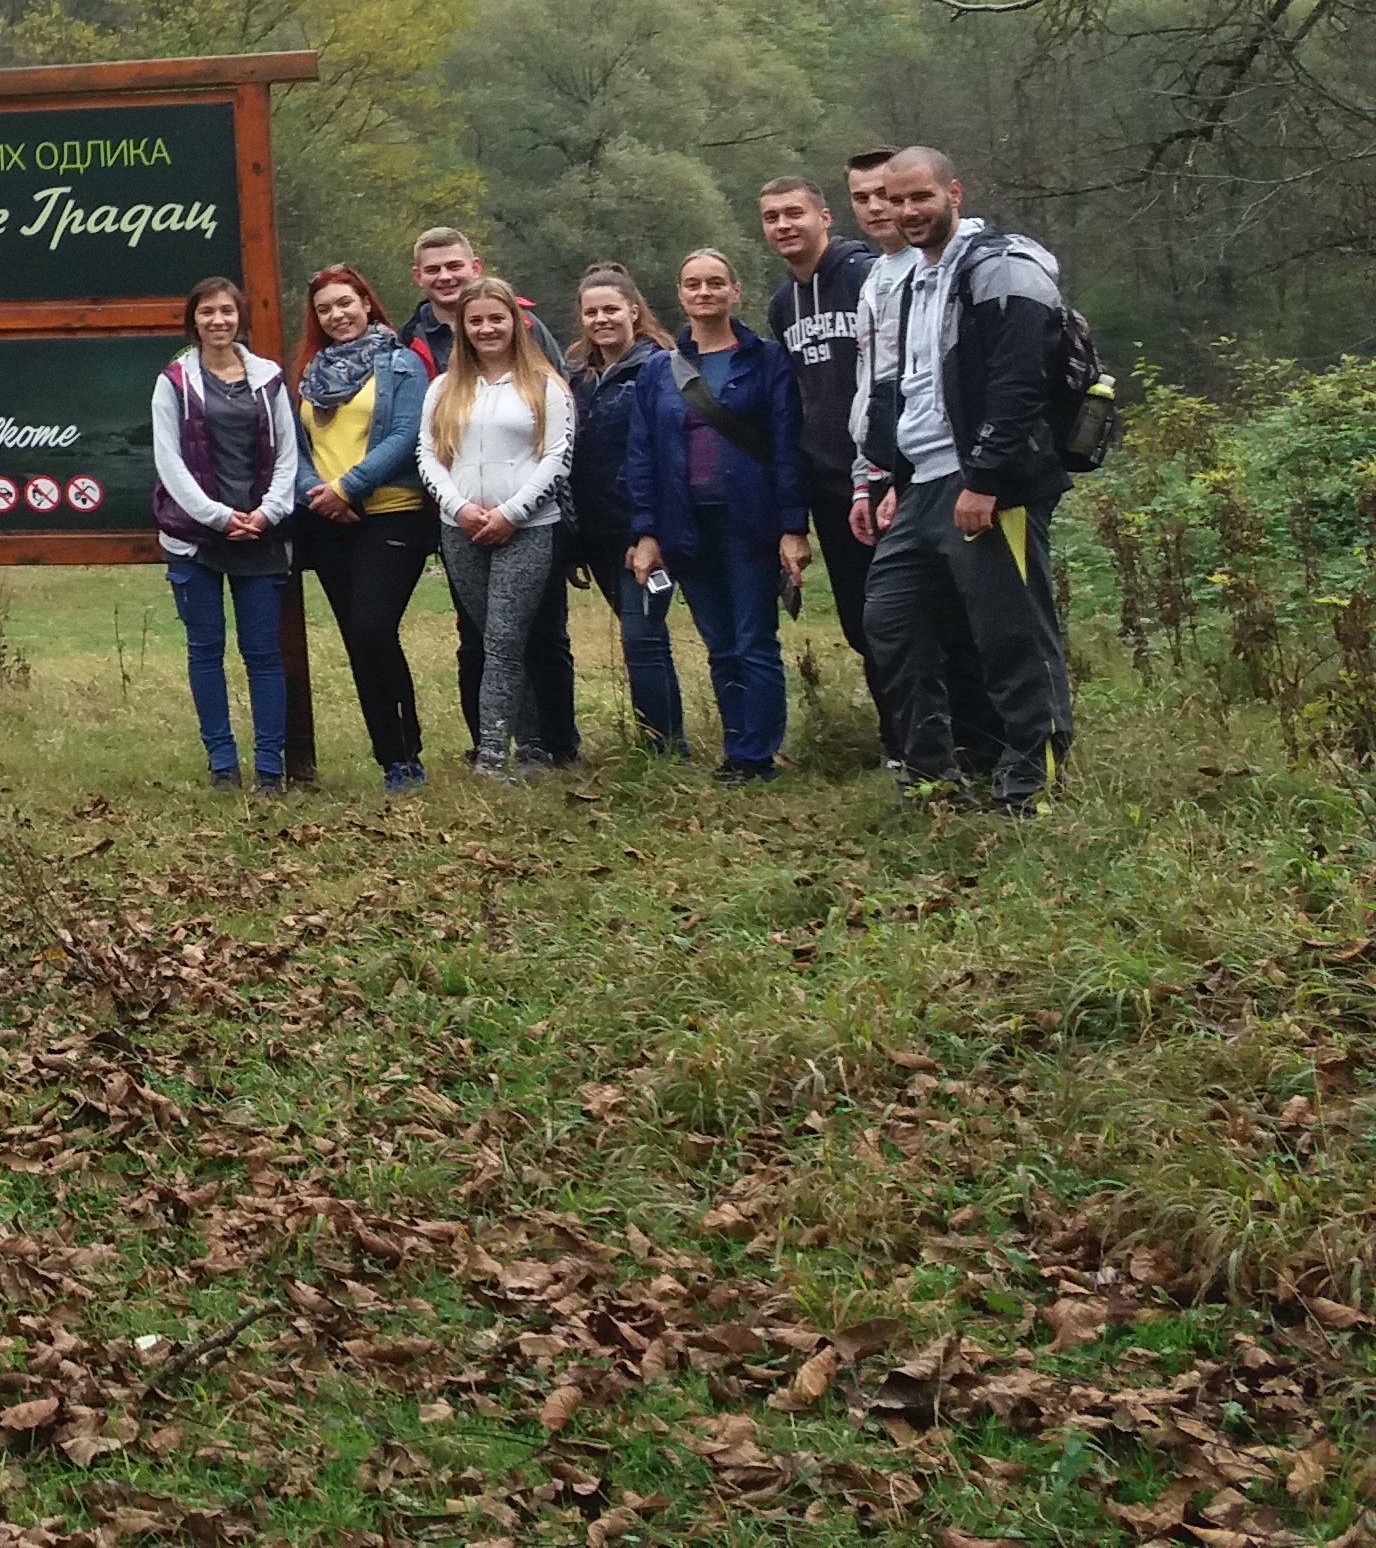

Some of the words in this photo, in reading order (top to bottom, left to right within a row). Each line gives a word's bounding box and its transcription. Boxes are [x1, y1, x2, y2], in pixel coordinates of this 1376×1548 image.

[35, 137, 172, 175] ОДЛИКА
[19, 186, 218, 250] Градац
[783, 311, 857, 352] ULL&BEAR
[802, 342, 831, 366] 1991
